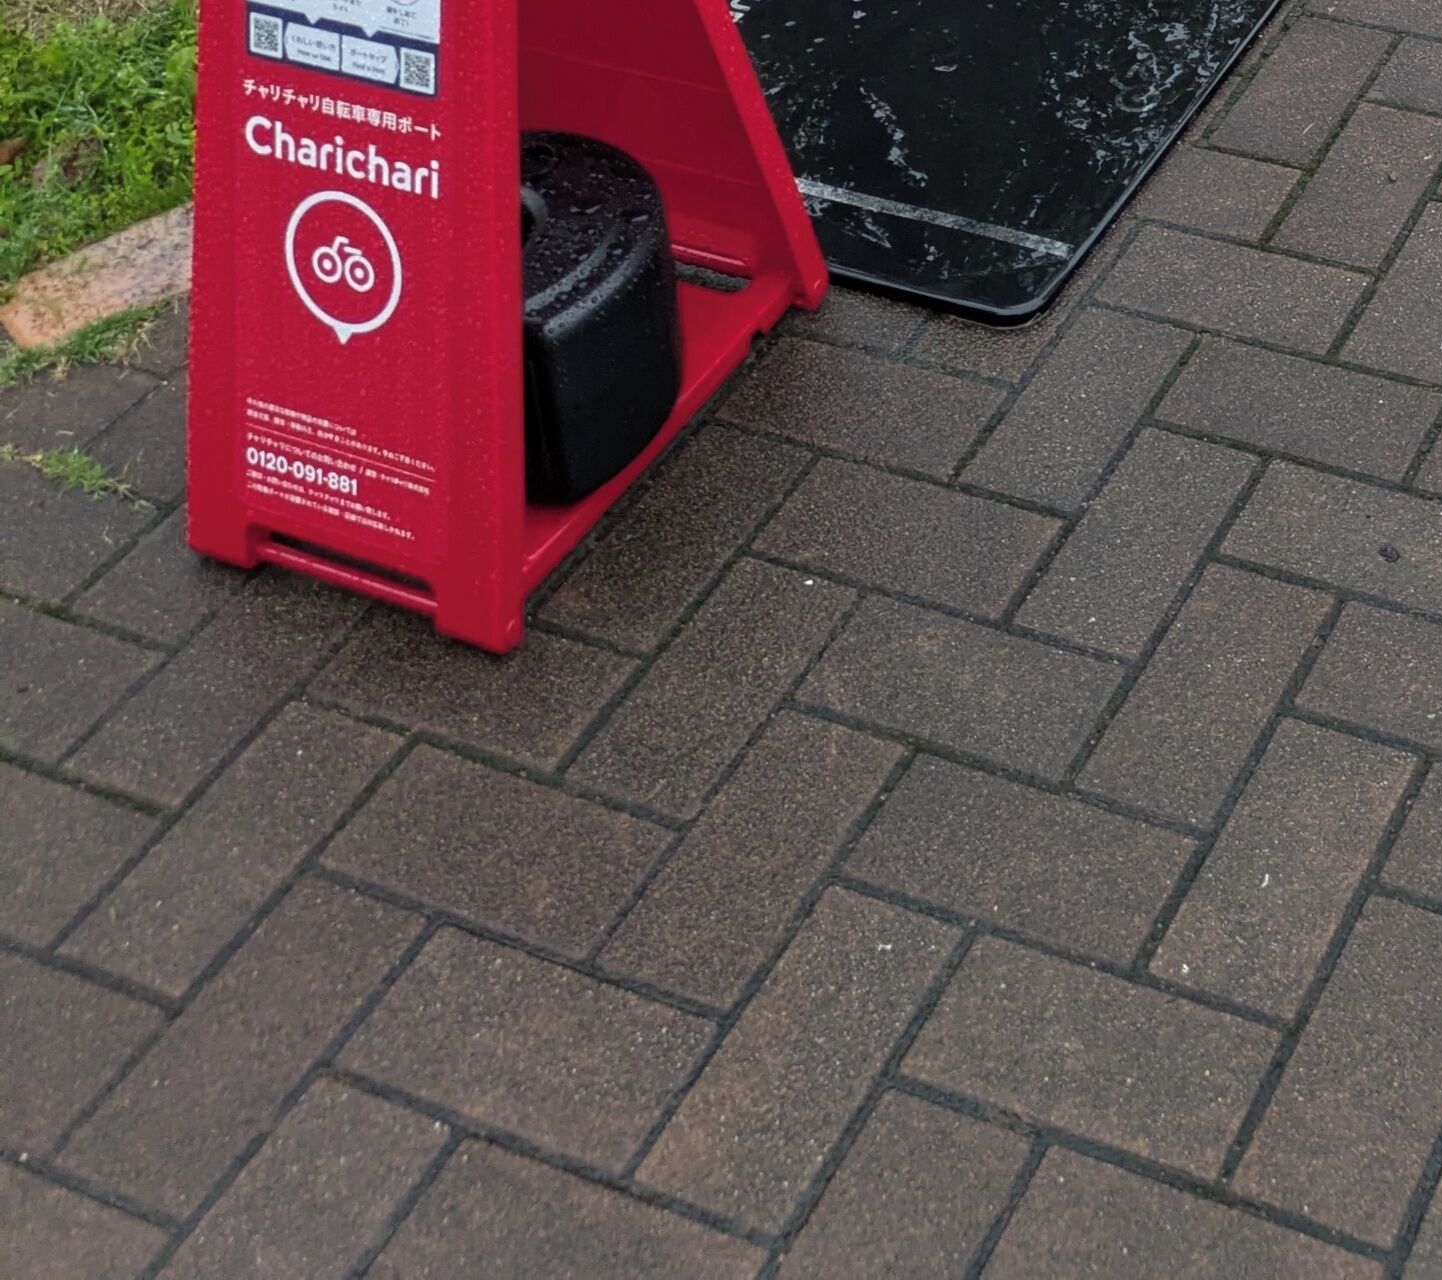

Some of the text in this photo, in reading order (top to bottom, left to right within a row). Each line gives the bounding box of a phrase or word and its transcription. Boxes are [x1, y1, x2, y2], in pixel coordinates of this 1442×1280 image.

[243, 78, 442, 141] チャリチャリ自転車専用ポート
[244, 114, 440, 200] Charichari
[246, 446, 358, 496] 0120-091-881
